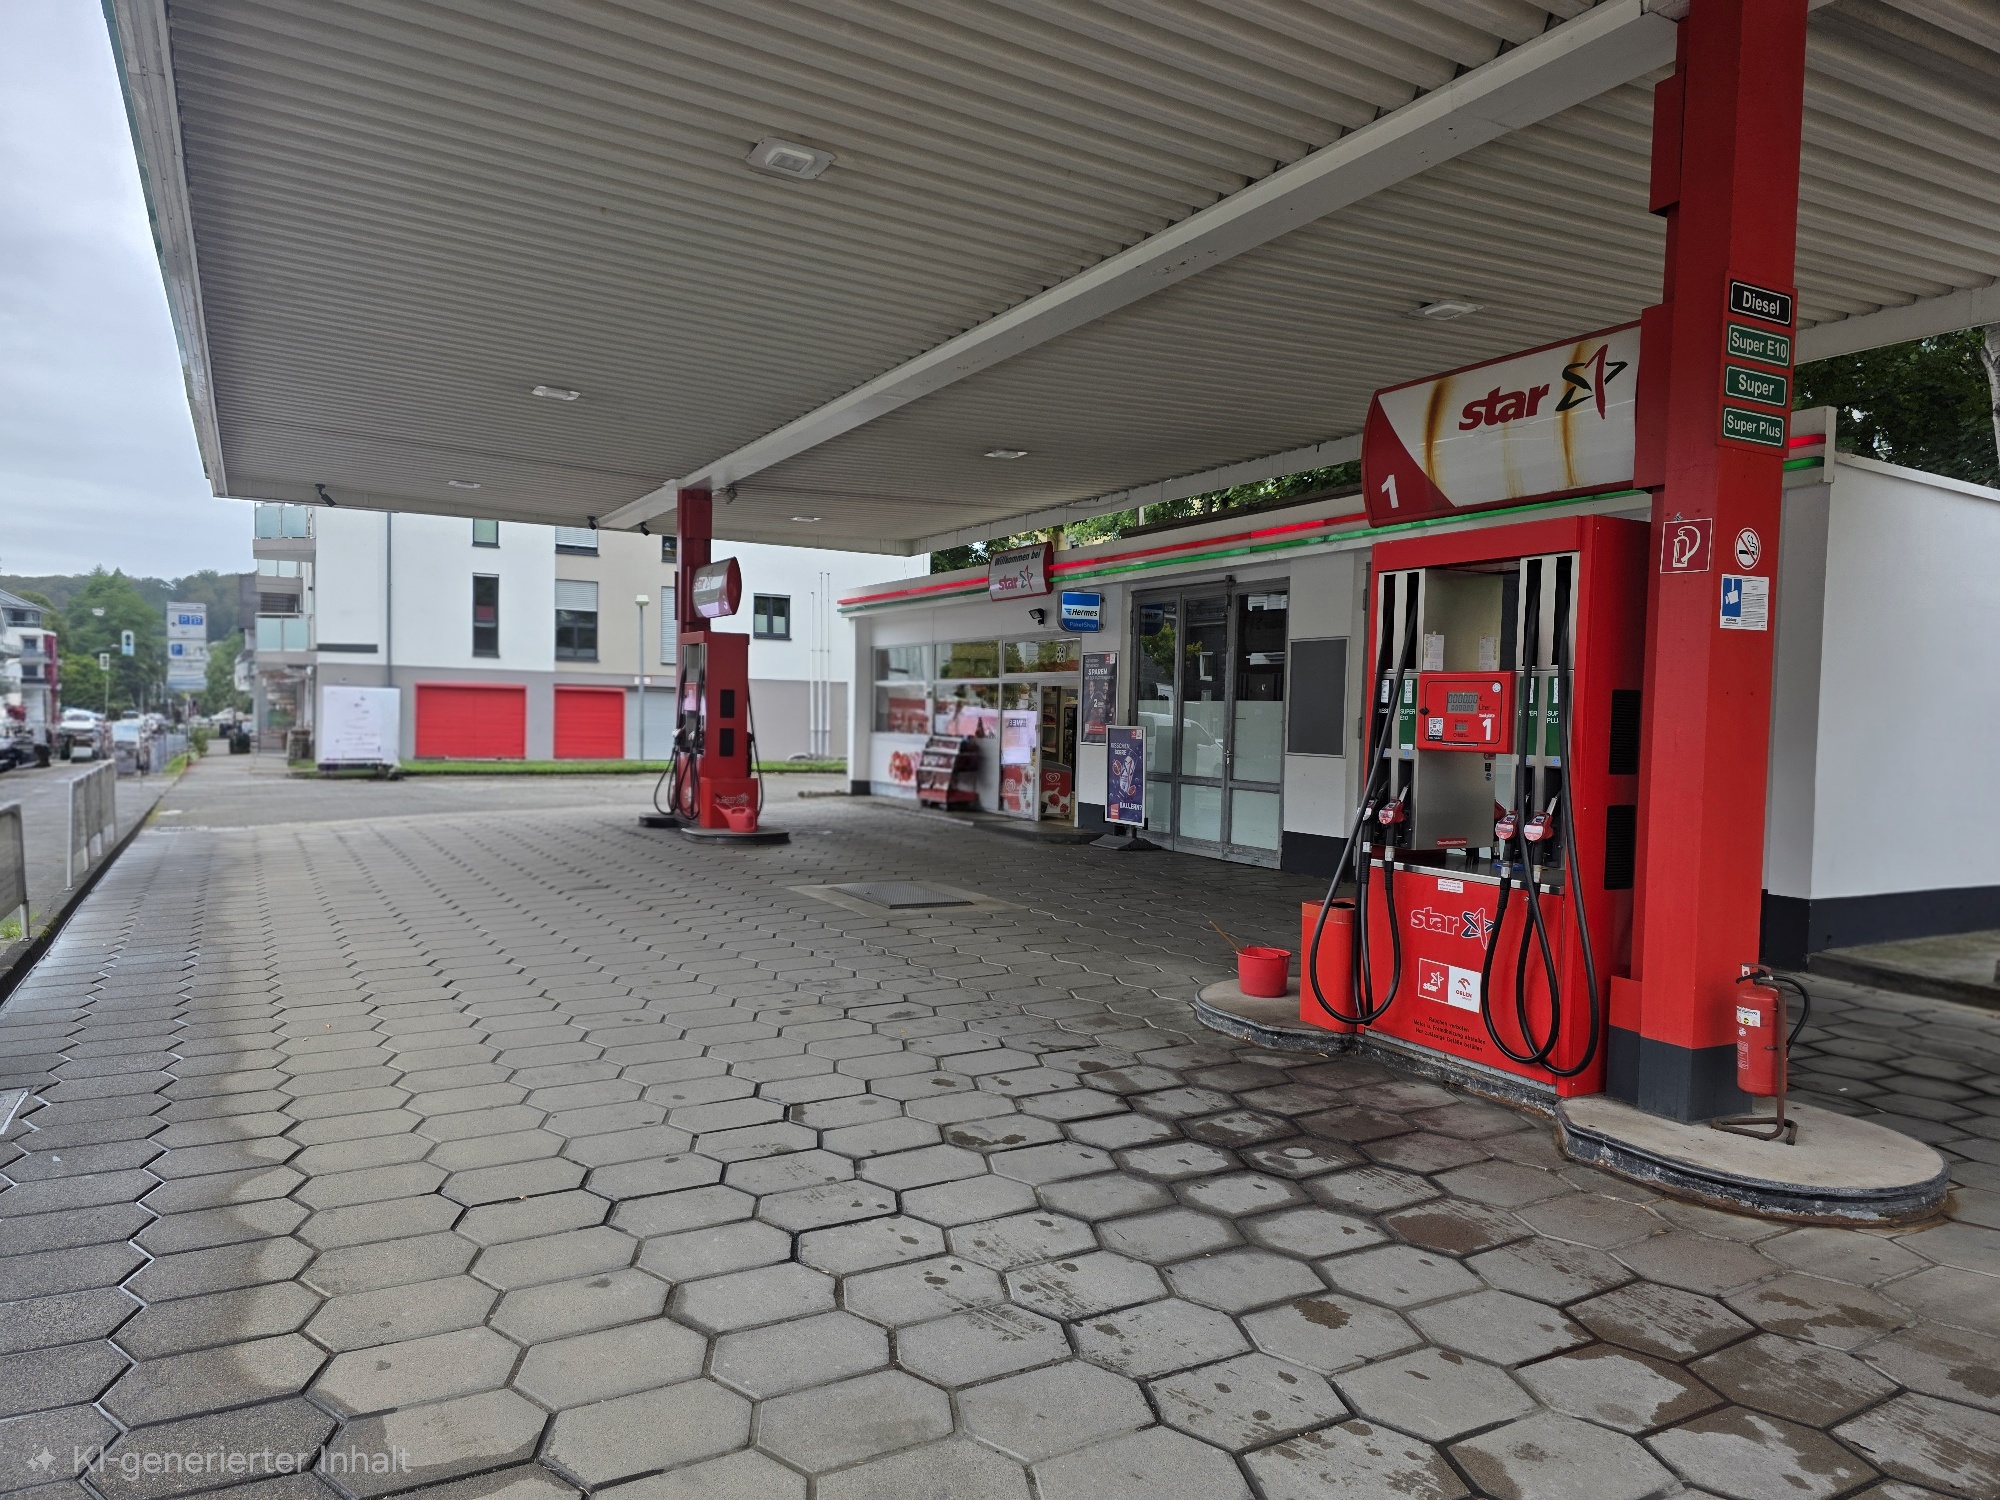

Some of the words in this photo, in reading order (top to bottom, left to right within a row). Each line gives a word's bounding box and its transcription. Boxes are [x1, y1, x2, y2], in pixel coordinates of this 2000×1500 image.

[1742, 290, 1780, 316] Diesel
[1731, 331, 1764, 354] Super
[1767, 340, 1787, 359] E10
[1738, 374, 1775, 397] Super
[1458, 383, 1550, 431] star
[1727, 414, 1757, 434] Super
[1759, 421, 1781, 438] Plus
[1381, 474, 1399, 509] 1
[994, 552, 1030, 567] Willkommen
[1030, 548, 1042, 560] bei
[998, 575, 1018, 591] star
[1072, 608, 1098, 617] Hermes
[1069, 621, 1097, 630] PaketShop
[1093, 698, 1098, 708] 2
[1482, 718, 1492, 741] 1
[1410, 906, 1460, 936] star
[1422, 982, 1439, 993] star
